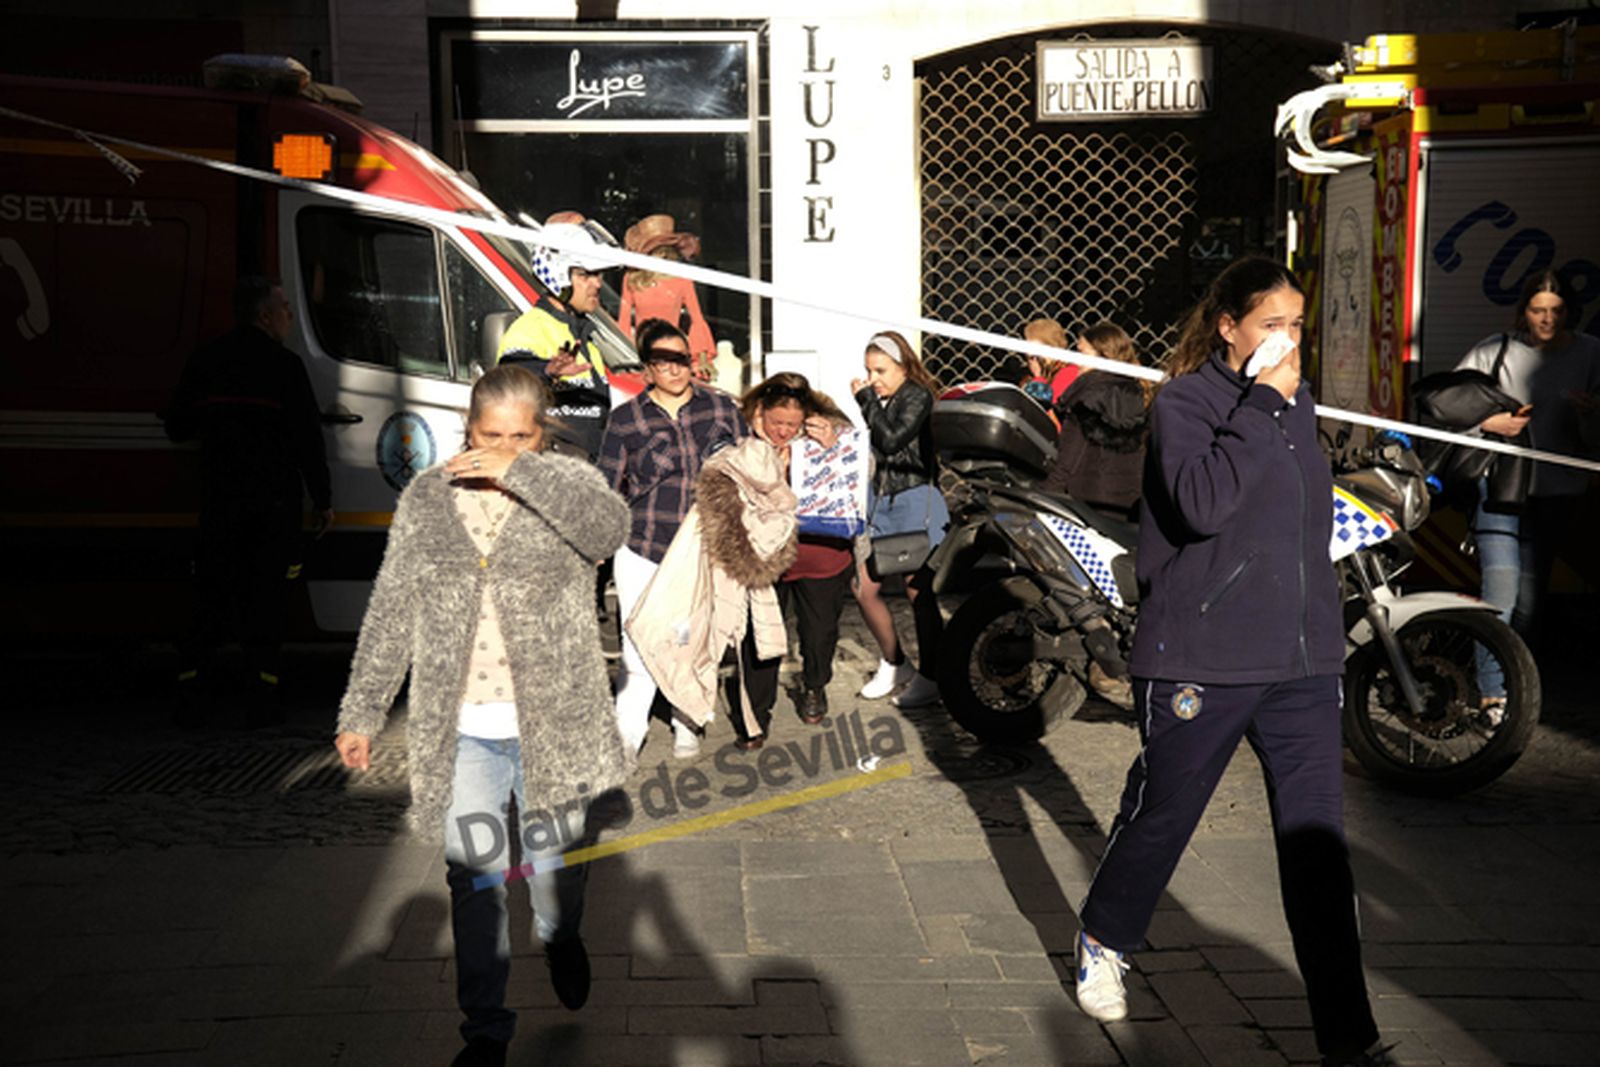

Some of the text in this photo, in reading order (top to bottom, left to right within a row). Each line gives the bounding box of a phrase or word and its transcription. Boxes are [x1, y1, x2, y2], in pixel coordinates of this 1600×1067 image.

[881, 63, 892, 82] 3
[1075, 48, 1182, 80] SALIDA A
[557, 49, 646, 118] Lupe
[1045, 81, 1124, 112] PUENTE
[1133, 79, 1212, 112] PELLON
[800, 26, 836, 242] LUPE
[0, 193, 153, 228] SEVILLA
[1378, 144, 1399, 418] BOMBERO
